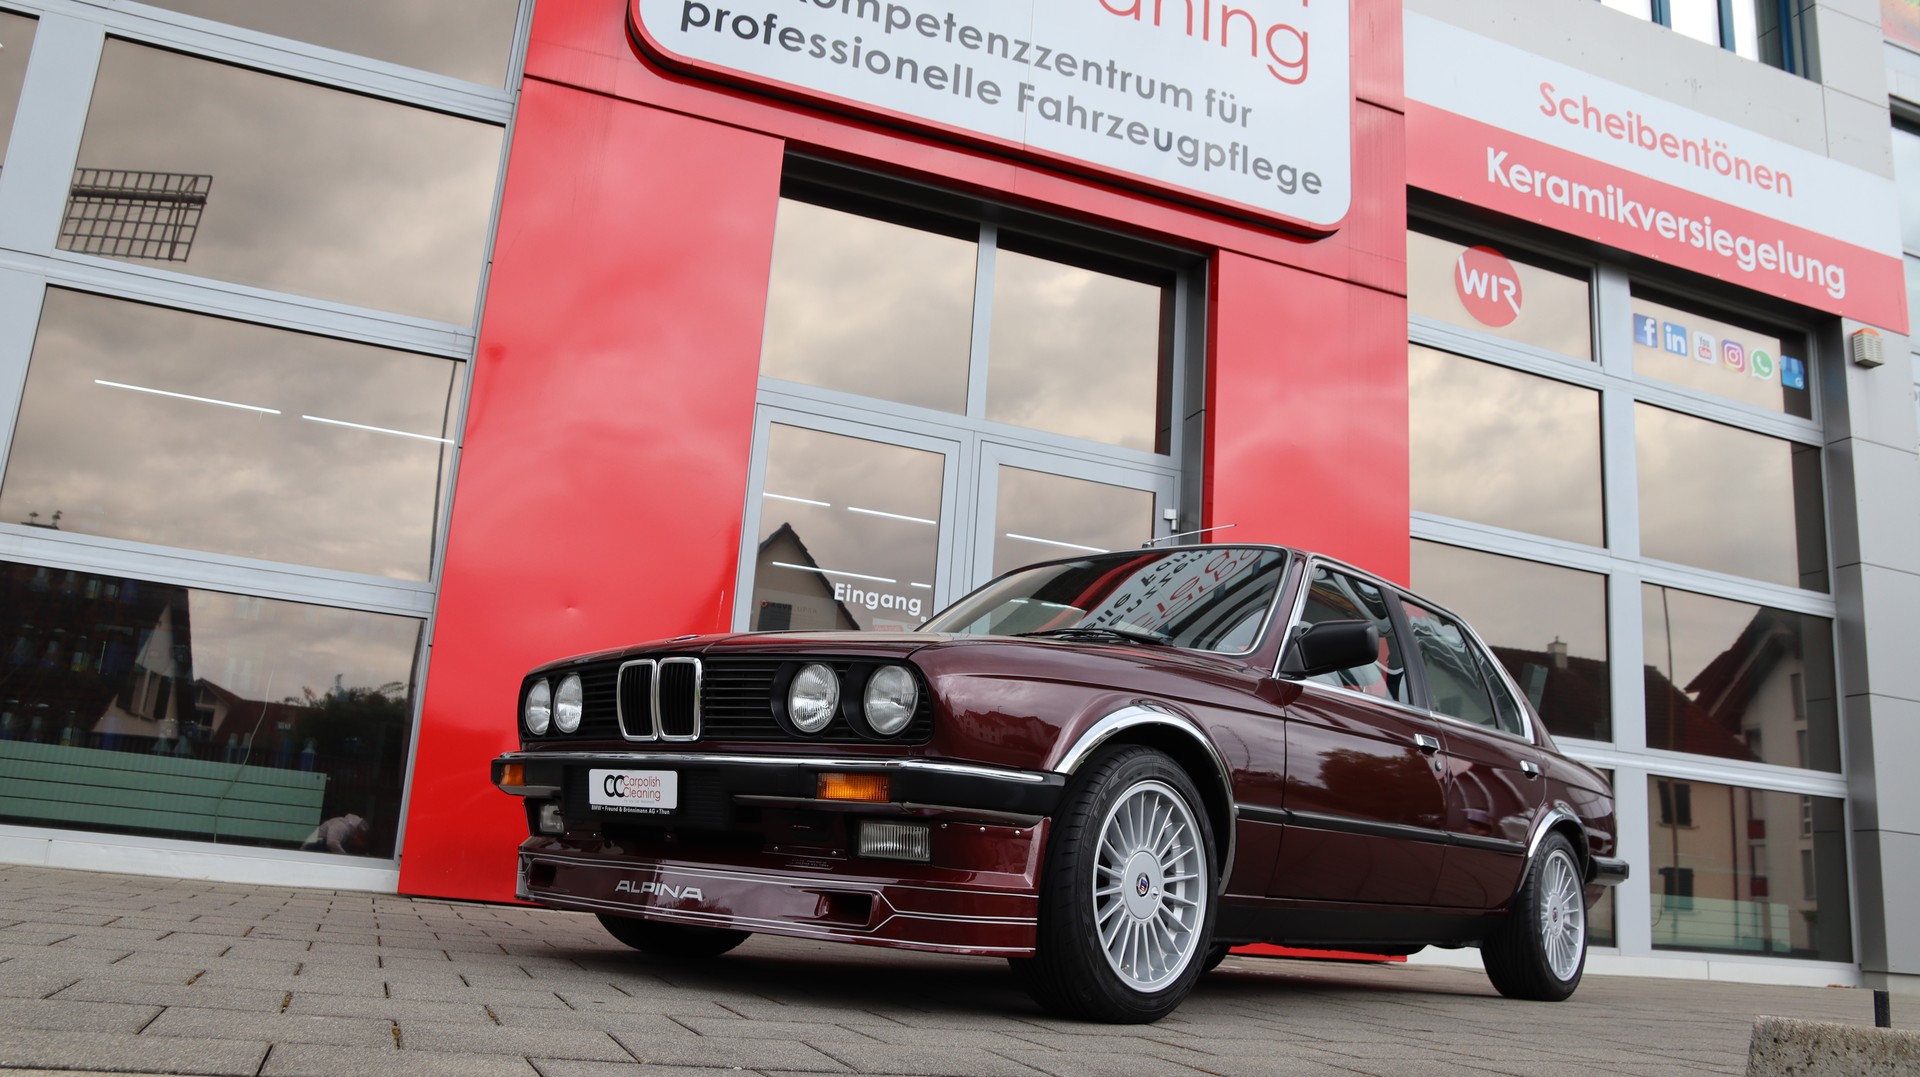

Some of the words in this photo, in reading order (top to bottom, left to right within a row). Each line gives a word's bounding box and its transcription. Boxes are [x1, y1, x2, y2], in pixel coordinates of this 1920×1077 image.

[680, 0, 1002, 105] professionelle
[1017, 82, 1323, 195] Fahrzeugpflege
[1205, 88, 1252, 128] für
[1539, 82, 1793, 197] Scheibentönen
[1486, 147, 1846, 299] Keramikversiegelung
[1458, 254, 1520, 315] WIR
[834, 583, 922, 617] Eingang
[623, 775, 661, 789] Carpolish
[623, 786, 661, 802] Cleaning
[623, 806, 648, 814] Brönnimann
[615, 880, 704, 902] ALPINA
